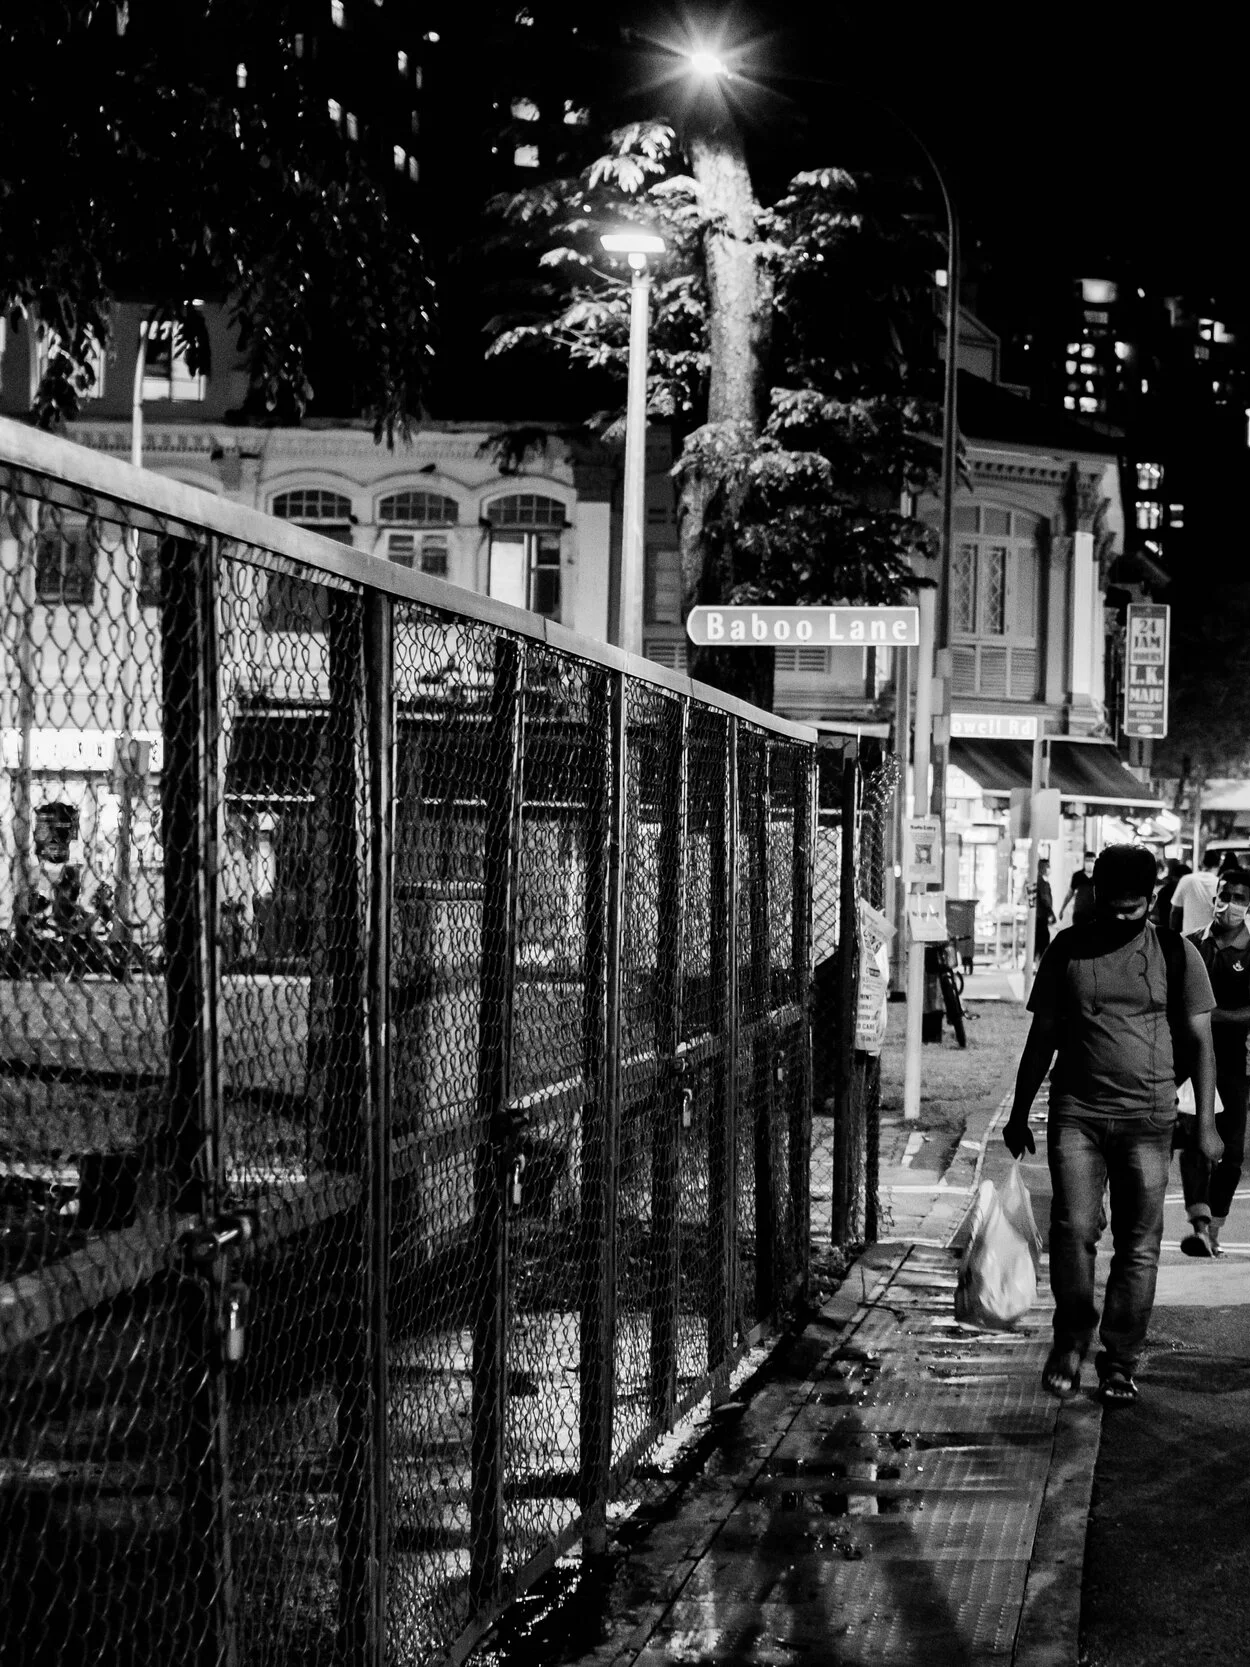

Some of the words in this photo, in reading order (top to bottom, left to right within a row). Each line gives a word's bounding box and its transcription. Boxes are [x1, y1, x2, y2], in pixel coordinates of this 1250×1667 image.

[707, 612, 813, 641] Baboo
[828, 613, 908, 641] Lane
[1139, 619, 1157, 634] 24
[951, 718, 1001, 736] owell
[1008, 718, 1031, 736] Rd
